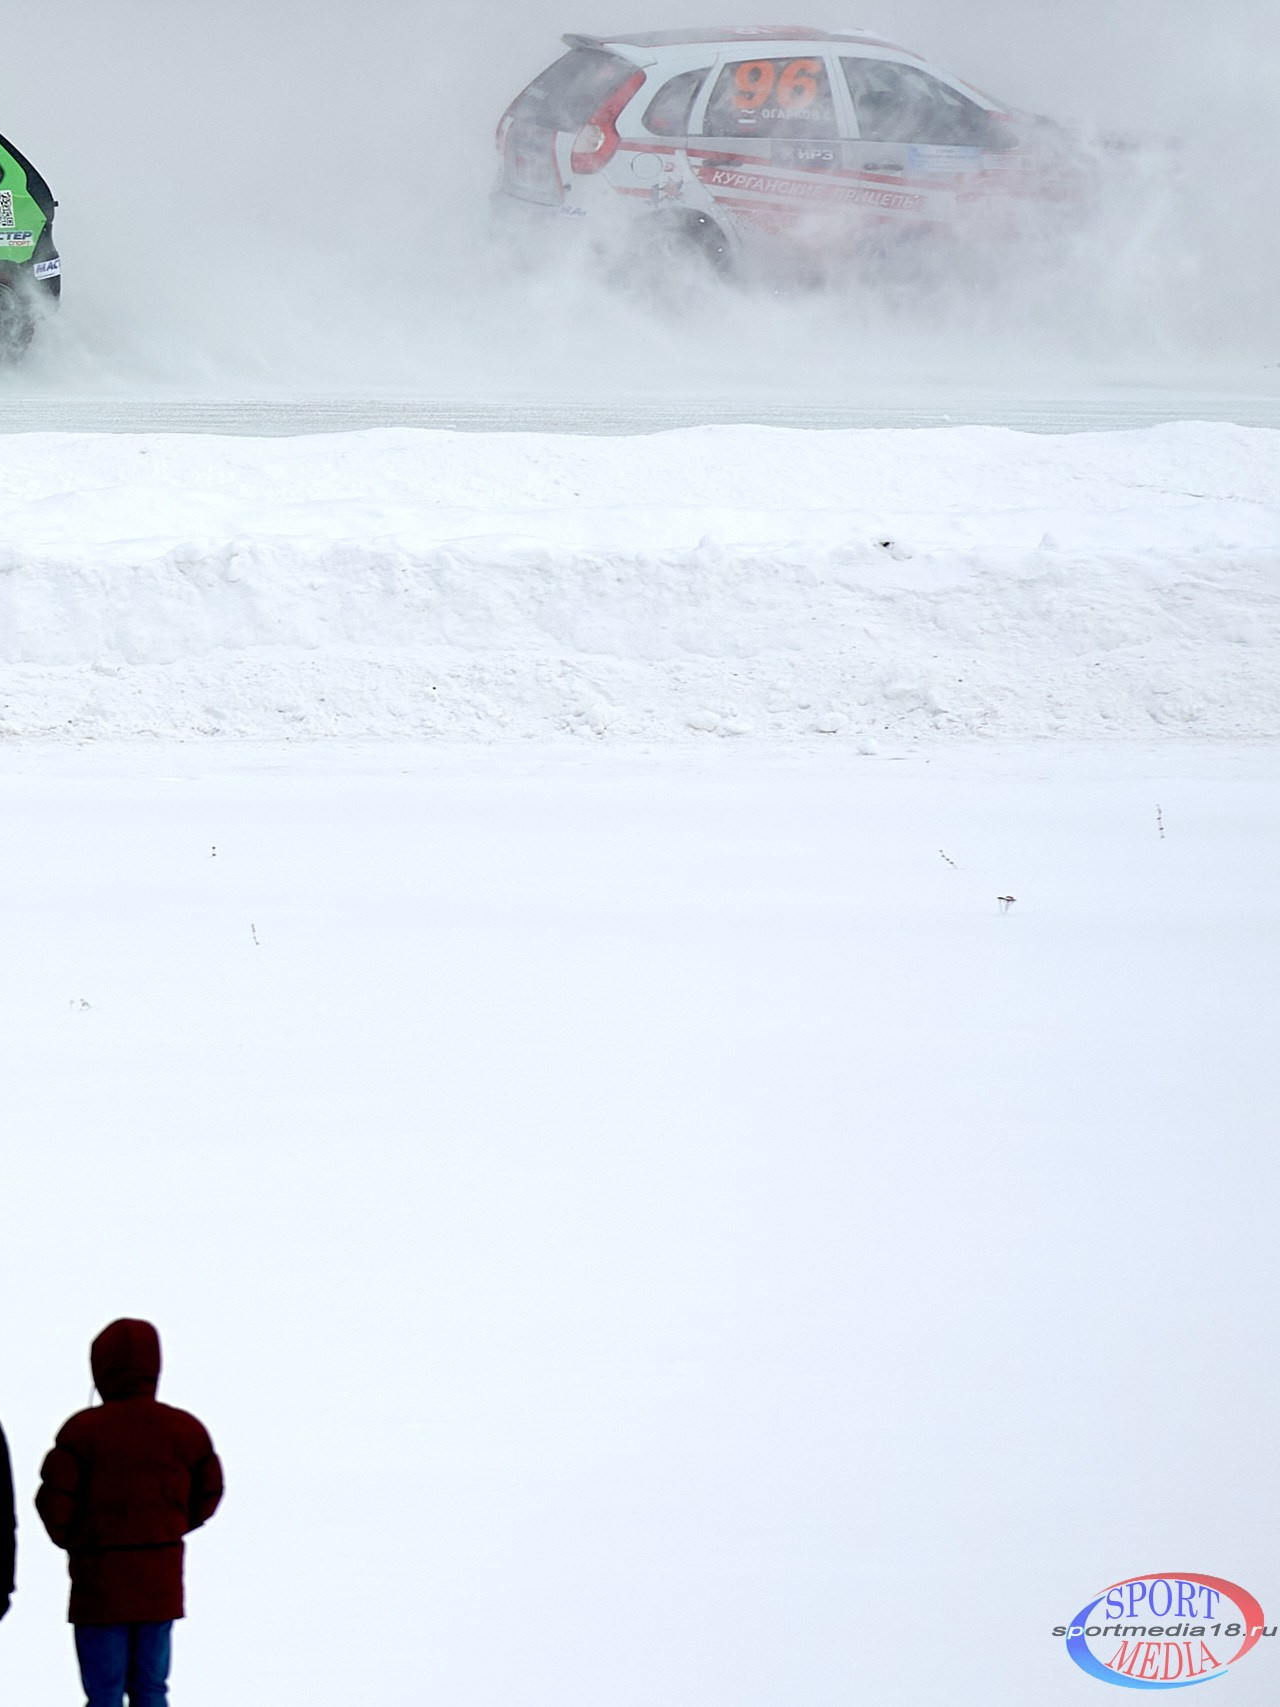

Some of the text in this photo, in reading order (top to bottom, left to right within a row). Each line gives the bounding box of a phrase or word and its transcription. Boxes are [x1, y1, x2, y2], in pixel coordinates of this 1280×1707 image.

[733, 59, 822, 109] 96
[762, 109, 819, 120] ОГАРКОВ
[798, 148, 834, 160] ИРЗ
[712, 171, 824, 198] КУРГАНСКИЕ
[35, 261, 60, 274] МАС
